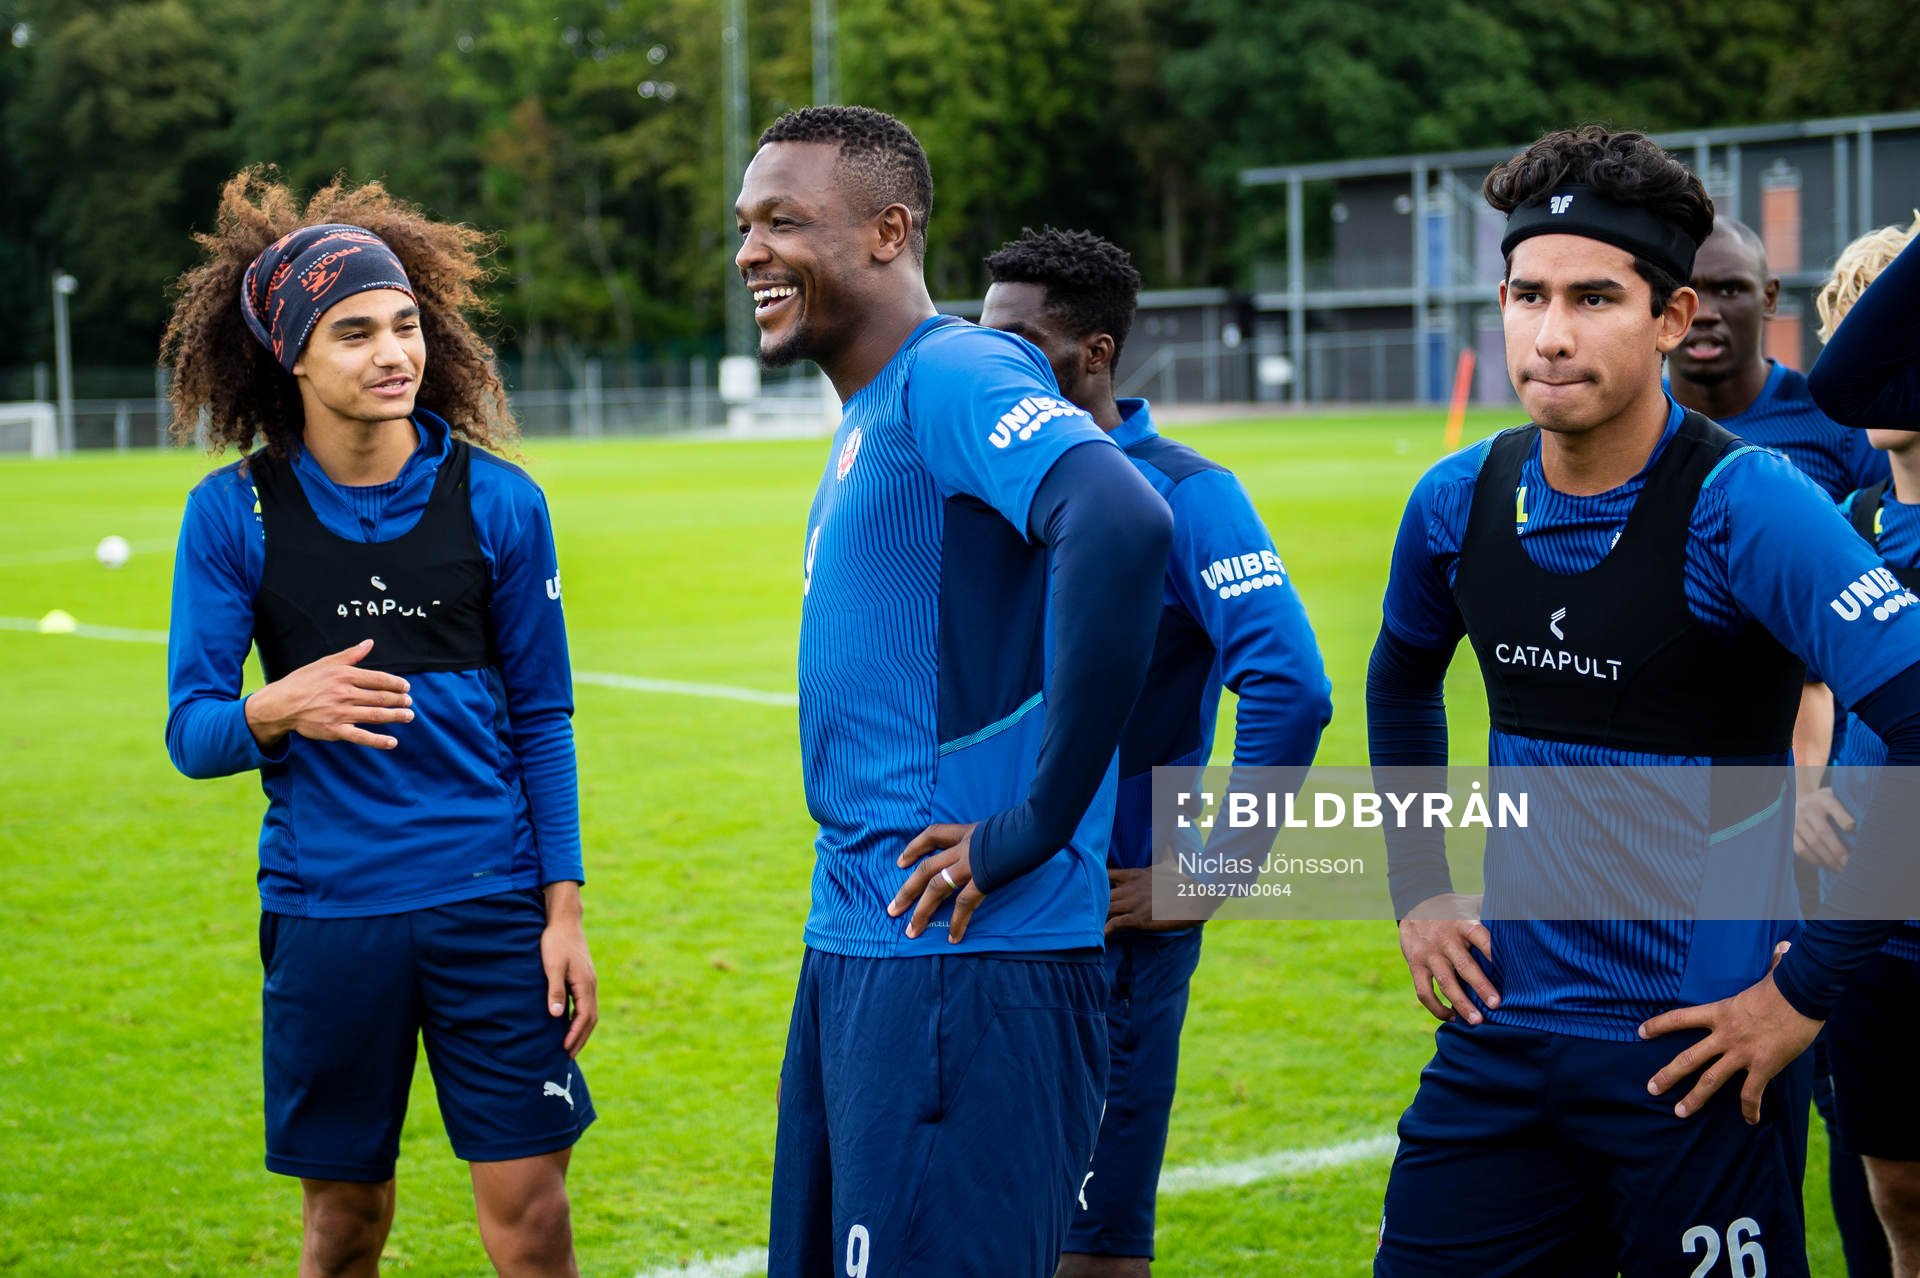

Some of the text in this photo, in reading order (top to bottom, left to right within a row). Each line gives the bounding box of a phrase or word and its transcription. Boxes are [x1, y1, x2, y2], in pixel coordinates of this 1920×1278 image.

[1495, 643, 1622, 681] CATAPULT
[846, 1224, 870, 1278] 9
[1681, 1217, 1767, 1278] 26
